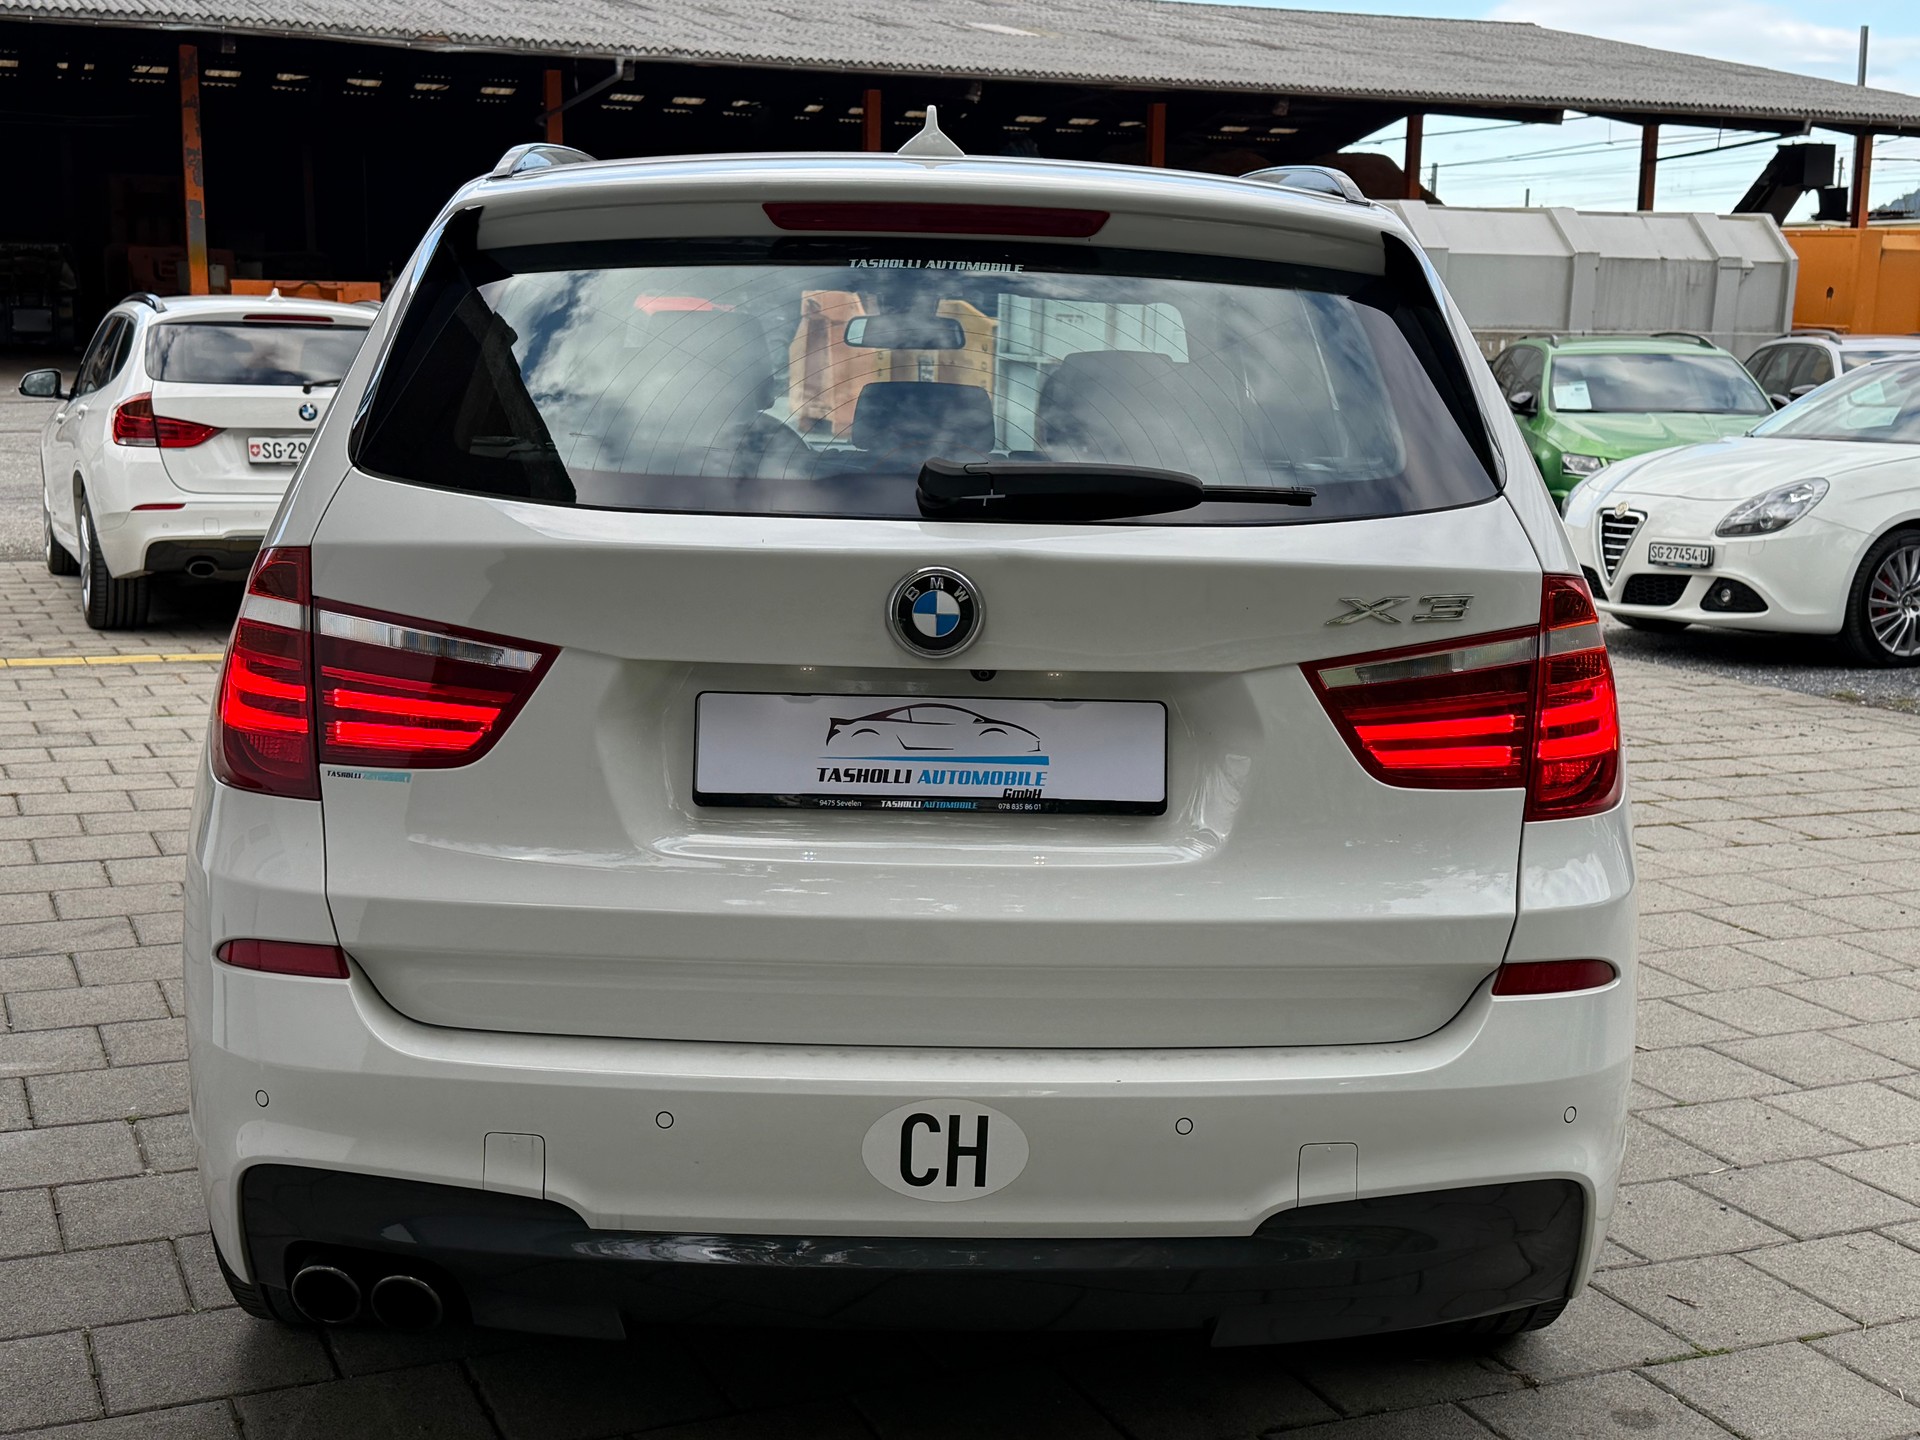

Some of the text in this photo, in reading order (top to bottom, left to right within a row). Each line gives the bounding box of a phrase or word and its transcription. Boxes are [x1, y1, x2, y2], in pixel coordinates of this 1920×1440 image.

[849, 258, 1024, 273] TASHOLLI AUTOMOBILE
[904, 577, 969, 602] BMW
[1325, 593, 1475, 625] X3
[817, 767, 1048, 787] TASHOLLI AUTOMOBILE
[1003, 788, 1042, 798] GmbH
[836, 800, 862, 808] Sevelen
[881, 800, 922, 809] TASHOLLI
[923, 801, 978, 810] AUTOMOBILE
[900, 1113, 989, 1188] CH
